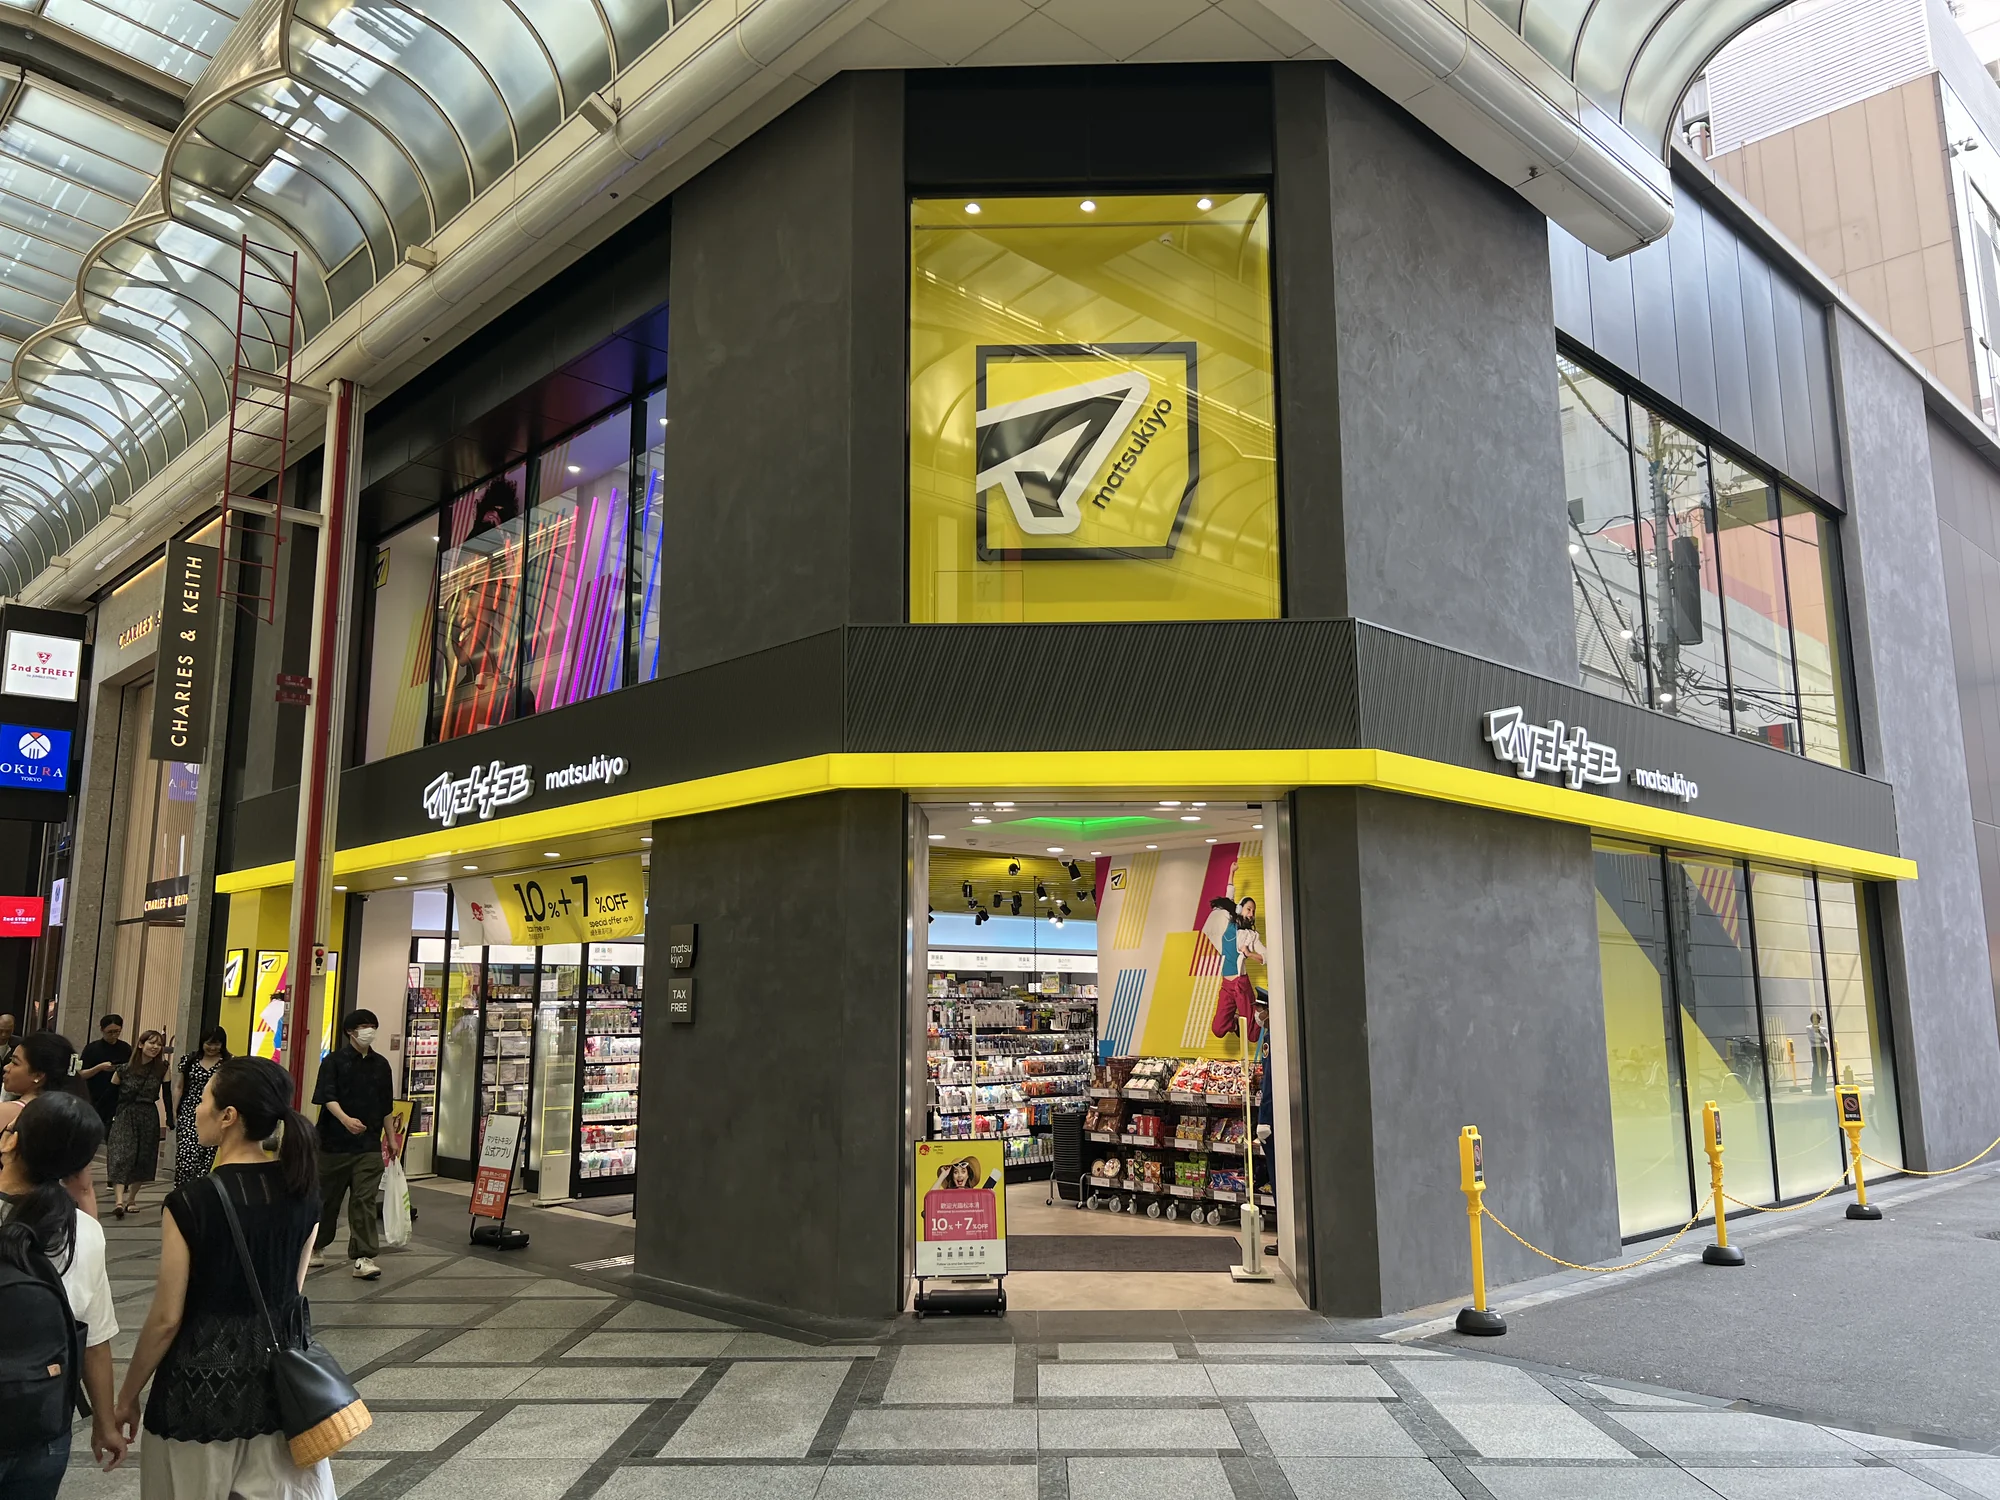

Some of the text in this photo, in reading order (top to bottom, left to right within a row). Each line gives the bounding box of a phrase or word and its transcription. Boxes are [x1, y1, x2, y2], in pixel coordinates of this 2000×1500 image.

[1092, 399, 1172, 510] matsukiyo
[118, 614, 153, 650] CHARLES
[171, 556, 203, 747] CHARLES & KEITH
[11, 664, 75, 678] 2nd STREET
[1485, 705, 1621, 789] マツモトキヨシ
[0, 762, 63, 778] OKURA
[546, 754, 628, 790] matsukiyo
[1635, 768, 1698, 802] matsukiyo
[423, 760, 532, 827] マツモトキヨシ
[144, 898, 166, 911] CHARLES
[589, 917, 607, 928] special
[608, 916, 622, 926] offer
[670, 943, 692, 953] matsu
[670, 953, 684, 968] kiyo
[672, 989, 686, 999] TAX
[670, 1002, 688, 1012] FREE
[487, 1135, 513, 1145] マツモトキヨシ
[485, 1145, 512, 1159] 公式アプリ
